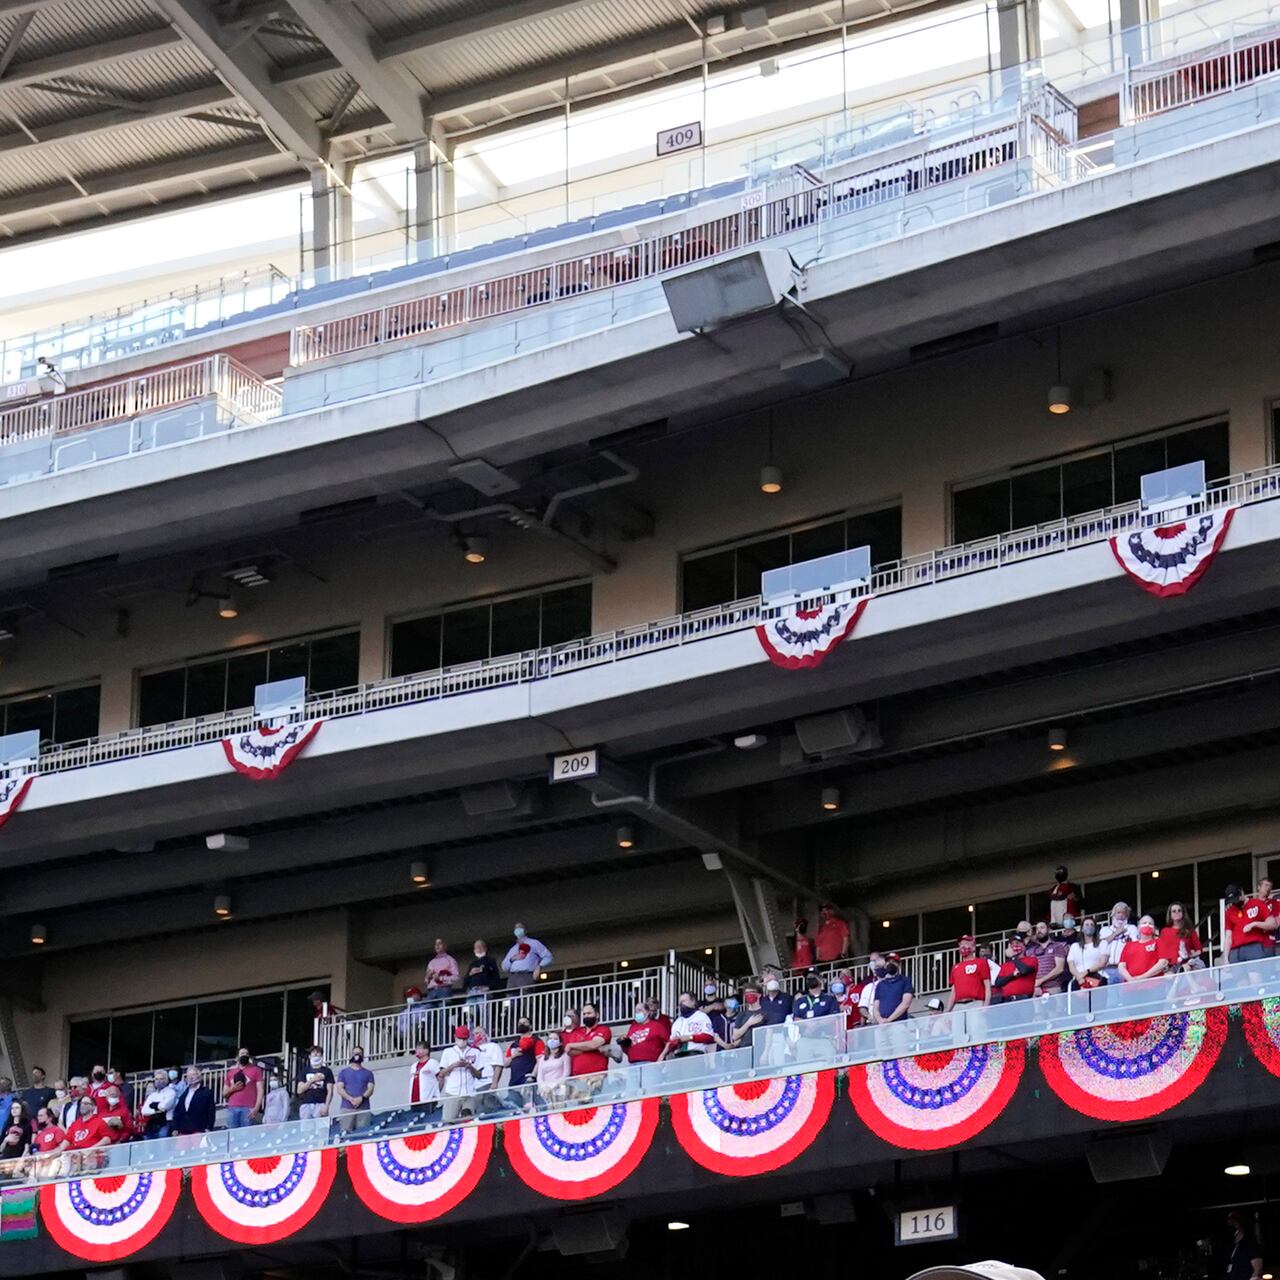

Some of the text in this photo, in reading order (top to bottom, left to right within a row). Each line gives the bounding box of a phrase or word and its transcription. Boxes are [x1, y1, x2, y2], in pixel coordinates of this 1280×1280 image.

[666, 129, 693, 148] 409
[561, 756, 590, 774] 209
[911, 1212, 945, 1234] 116
